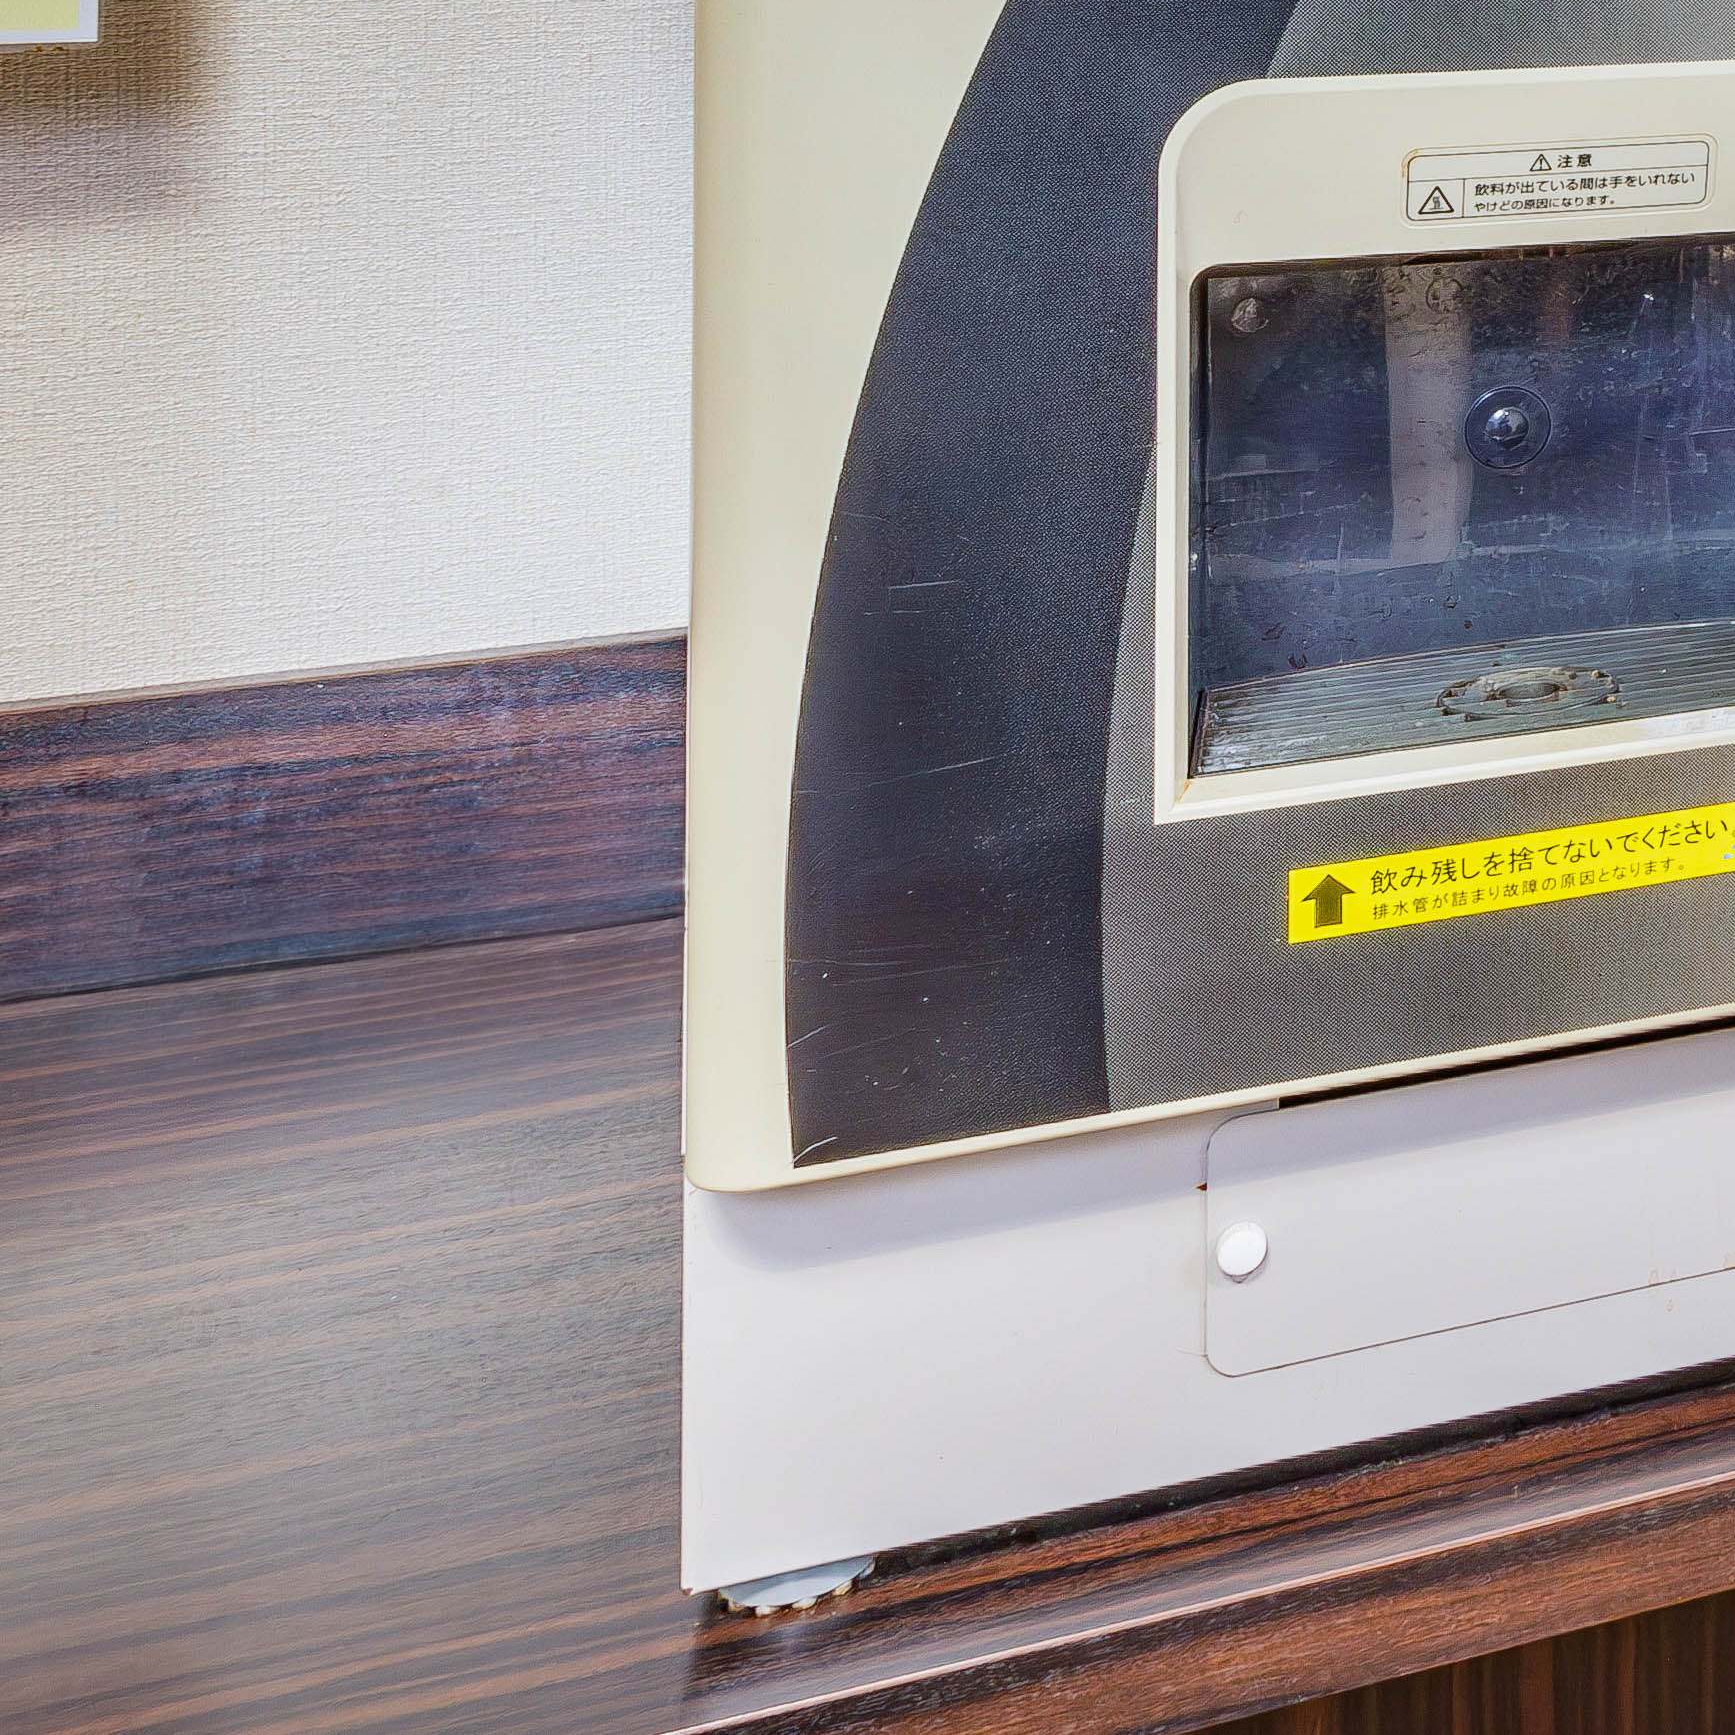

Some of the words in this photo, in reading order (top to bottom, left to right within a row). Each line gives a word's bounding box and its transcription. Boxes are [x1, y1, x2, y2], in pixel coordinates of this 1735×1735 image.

[1556, 152, 1593, 169] 注意
[1474, 171, 1696, 197] 飲料が出ている間は手をいれない
[1473, 194, 1617, 214] やけどの原因になります。
[1371, 856, 1686, 922] 排水管が詰まり故障の原因となります。
